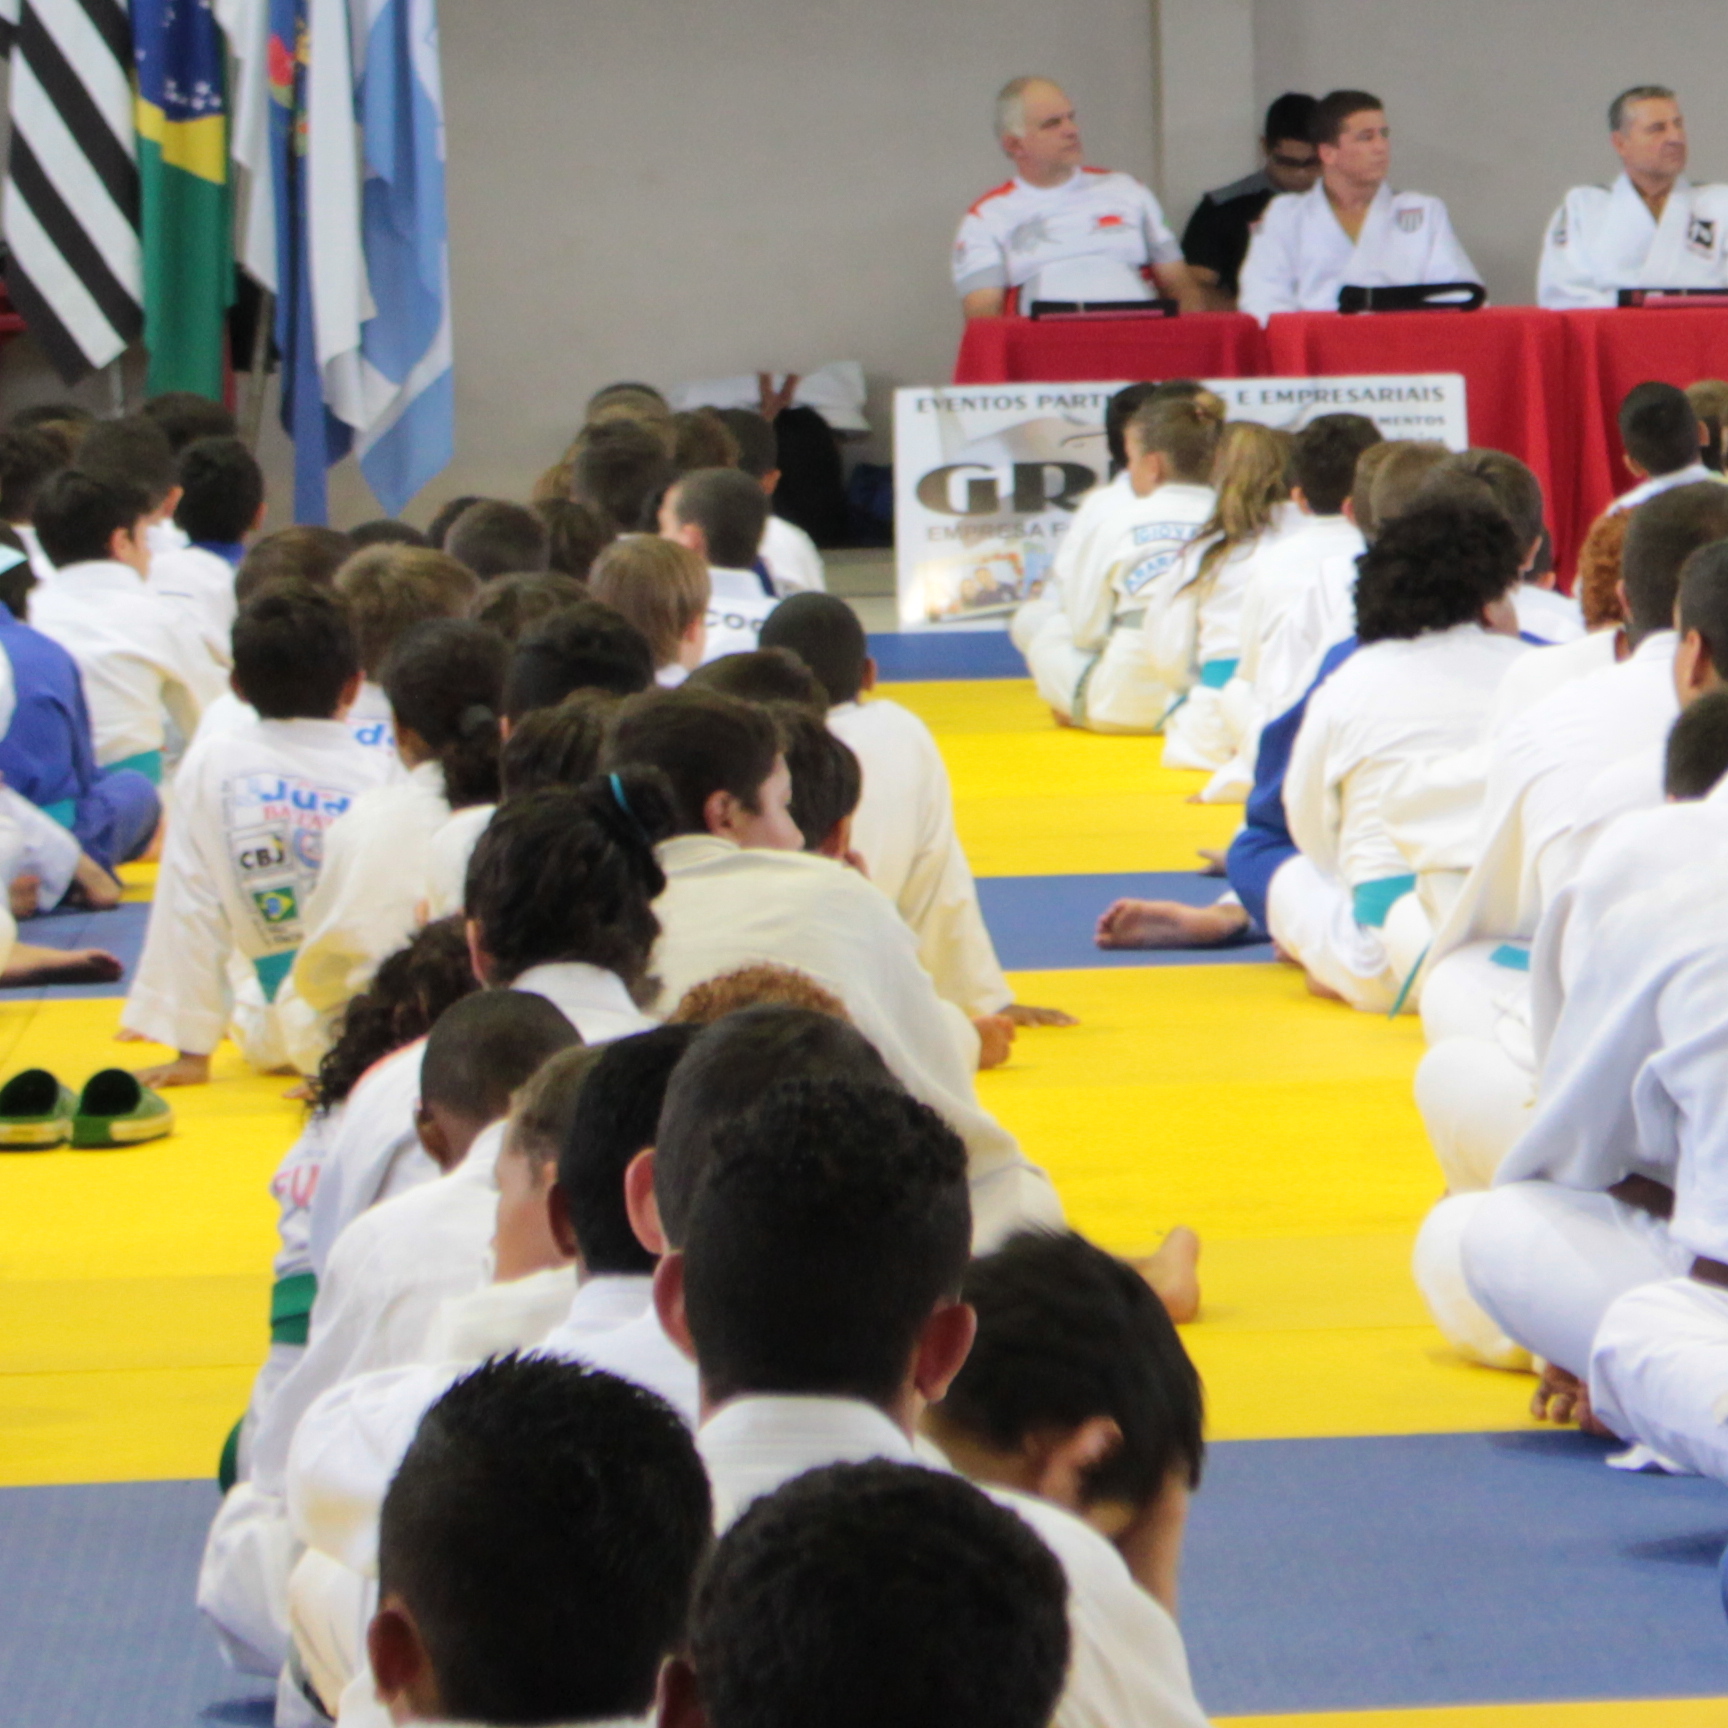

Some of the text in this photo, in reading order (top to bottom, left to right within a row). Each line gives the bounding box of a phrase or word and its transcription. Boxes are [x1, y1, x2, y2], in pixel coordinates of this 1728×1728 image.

[916, 395, 1028, 414] EVENTOS
[1237, 388, 1251, 405] E
[1260, 386, 1445, 405] EMPRESARIAIS
[927, 523, 1045, 541] EMPRESA
[240, 836, 286, 870] CBJ
